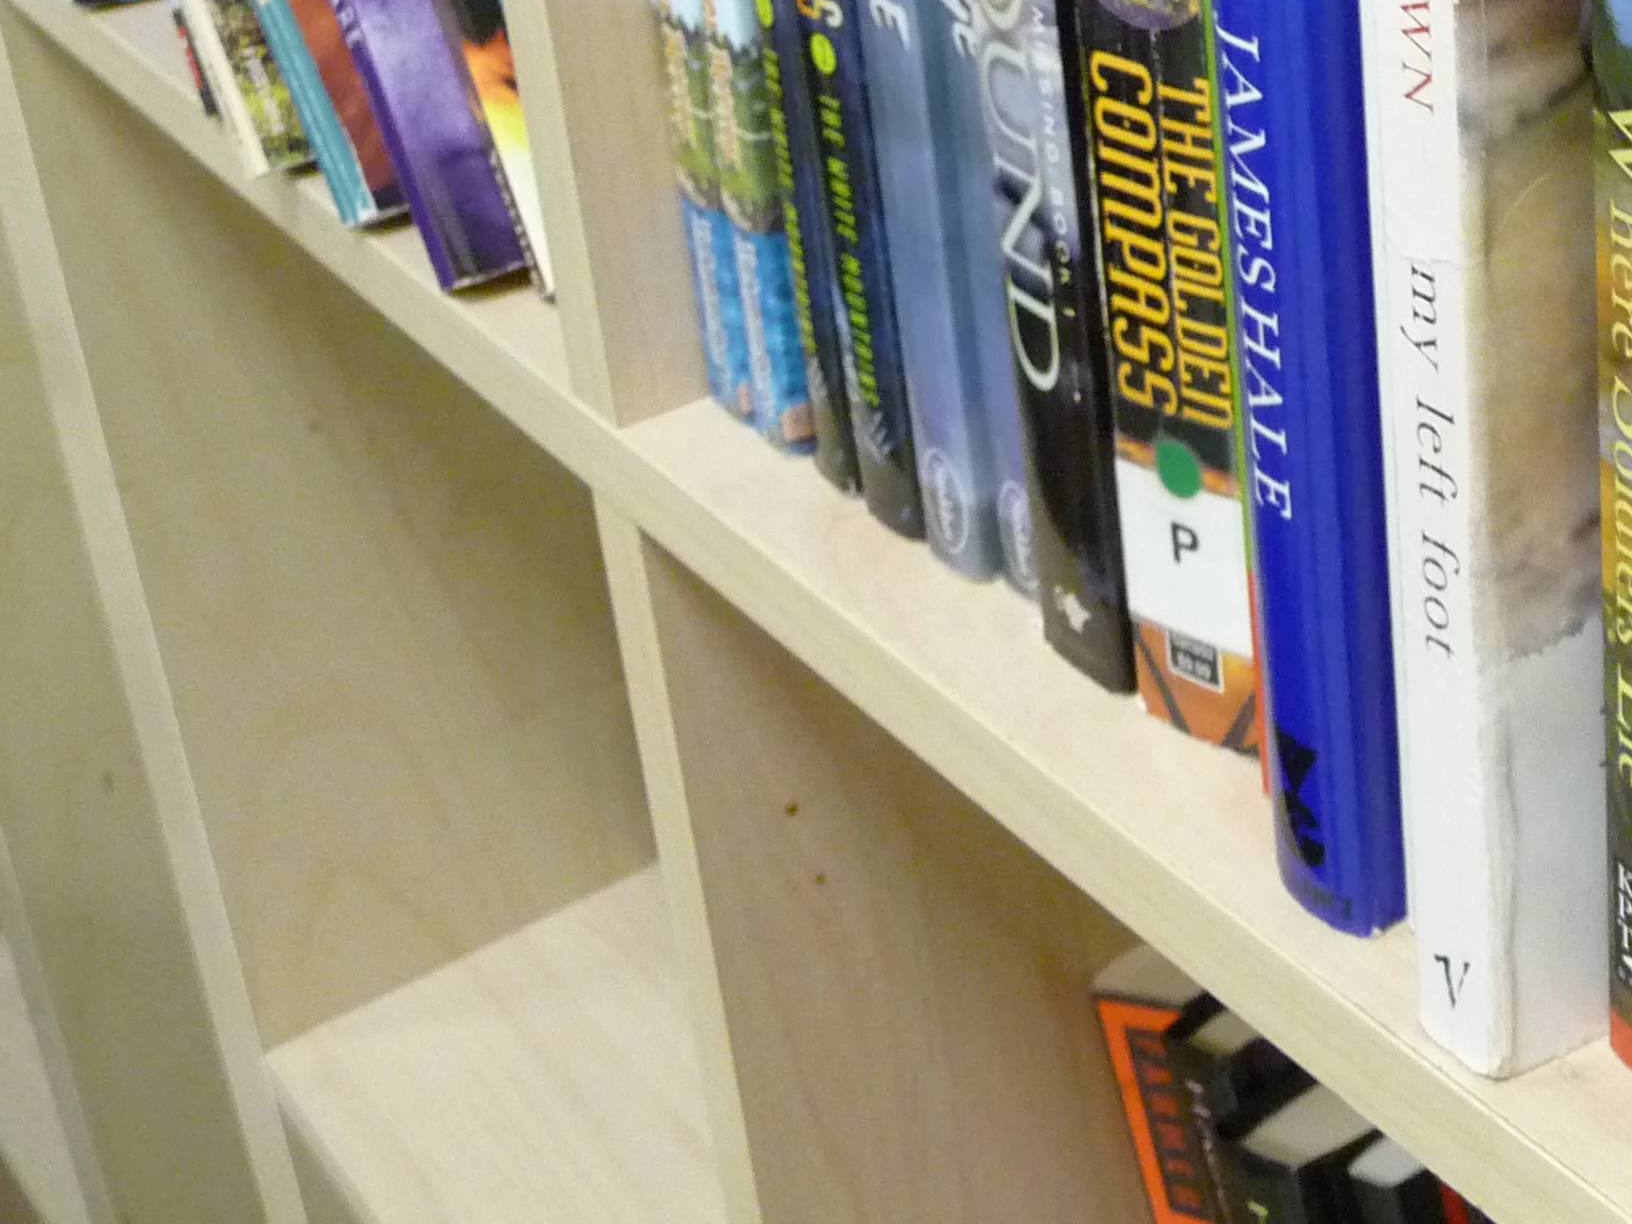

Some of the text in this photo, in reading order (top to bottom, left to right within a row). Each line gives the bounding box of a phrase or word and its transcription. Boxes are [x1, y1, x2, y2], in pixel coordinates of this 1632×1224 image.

[1089, 49, 1179, 418] COMPASS
[1157, 76, 1234, 432] THE GOLDEN
[1213, 9, 1293, 522] JAMES HALE
[1171, 521, 1200, 565] P
[1400, 262, 1462, 661] my left foot
[1434, 953, 1470, 1009] V
